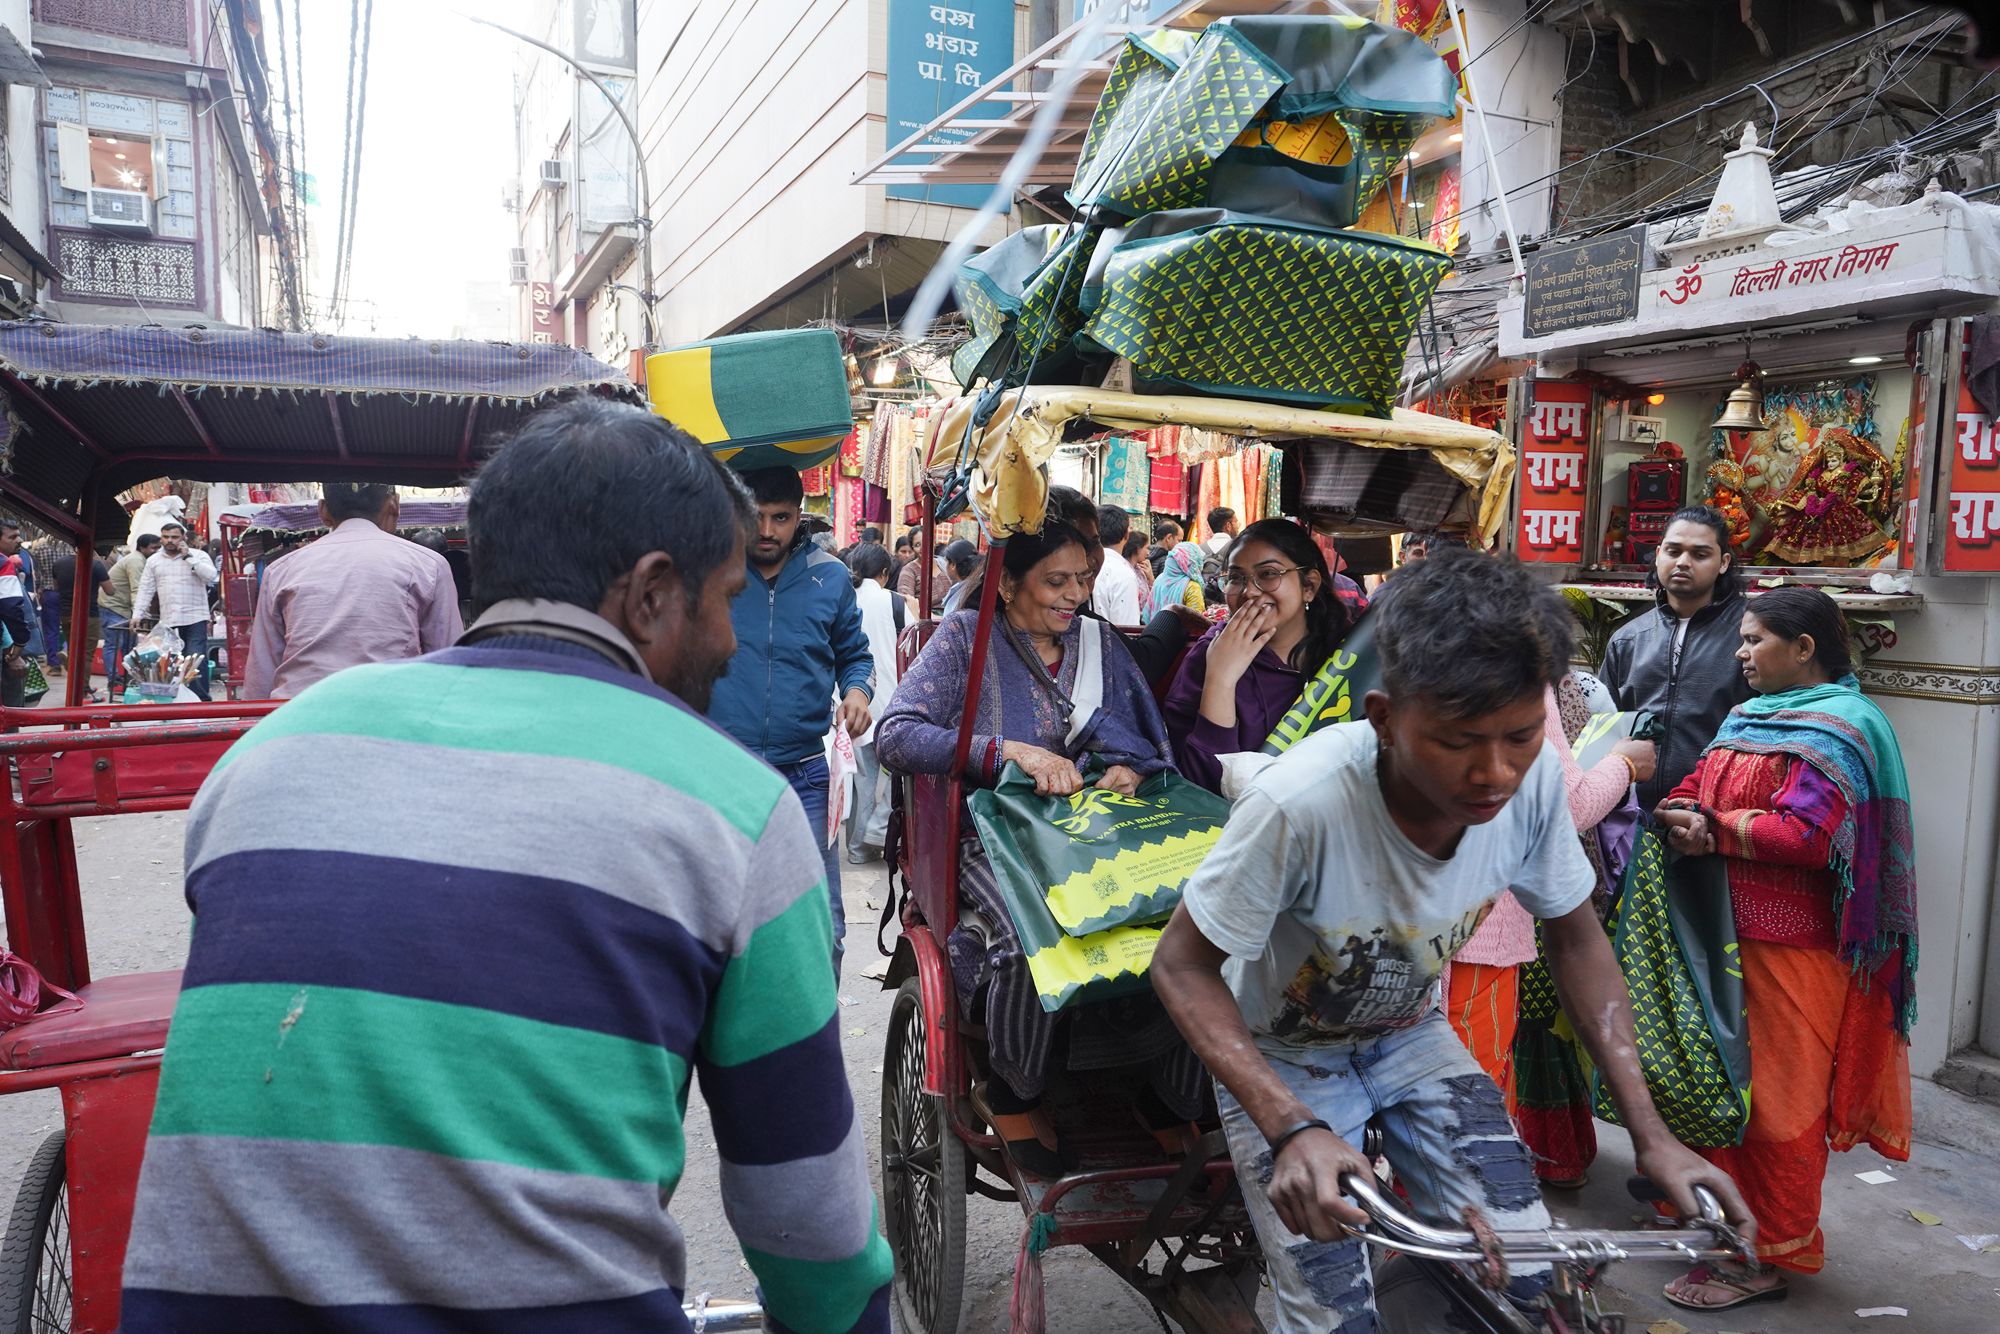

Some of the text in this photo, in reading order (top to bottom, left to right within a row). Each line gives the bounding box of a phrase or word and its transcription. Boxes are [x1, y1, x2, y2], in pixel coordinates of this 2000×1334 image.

[925, 32, 979, 57] भंडार
[918, 61, 947, 82] प्रा.
[1558, 267, 1584, 285] प्राचीन
[1585, 263, 1603, 280] शिव
[1606, 258, 1636, 274] मन्दिर
[1730, 241, 1899, 298] दिल्ली नगर निगम
[1572, 286, 1582, 296] का
[1529, 402, 1586, 438] राम
[1957, 413, 2000, 460] रा
[1525, 453, 1583, 487] राम
[1522, 510, 1581, 545] राम
[1375, 958, 1414, 974] THOSE
[1369, 972, 1410, 988] WHO
[1361, 987, 1424, 1004] DON'T
